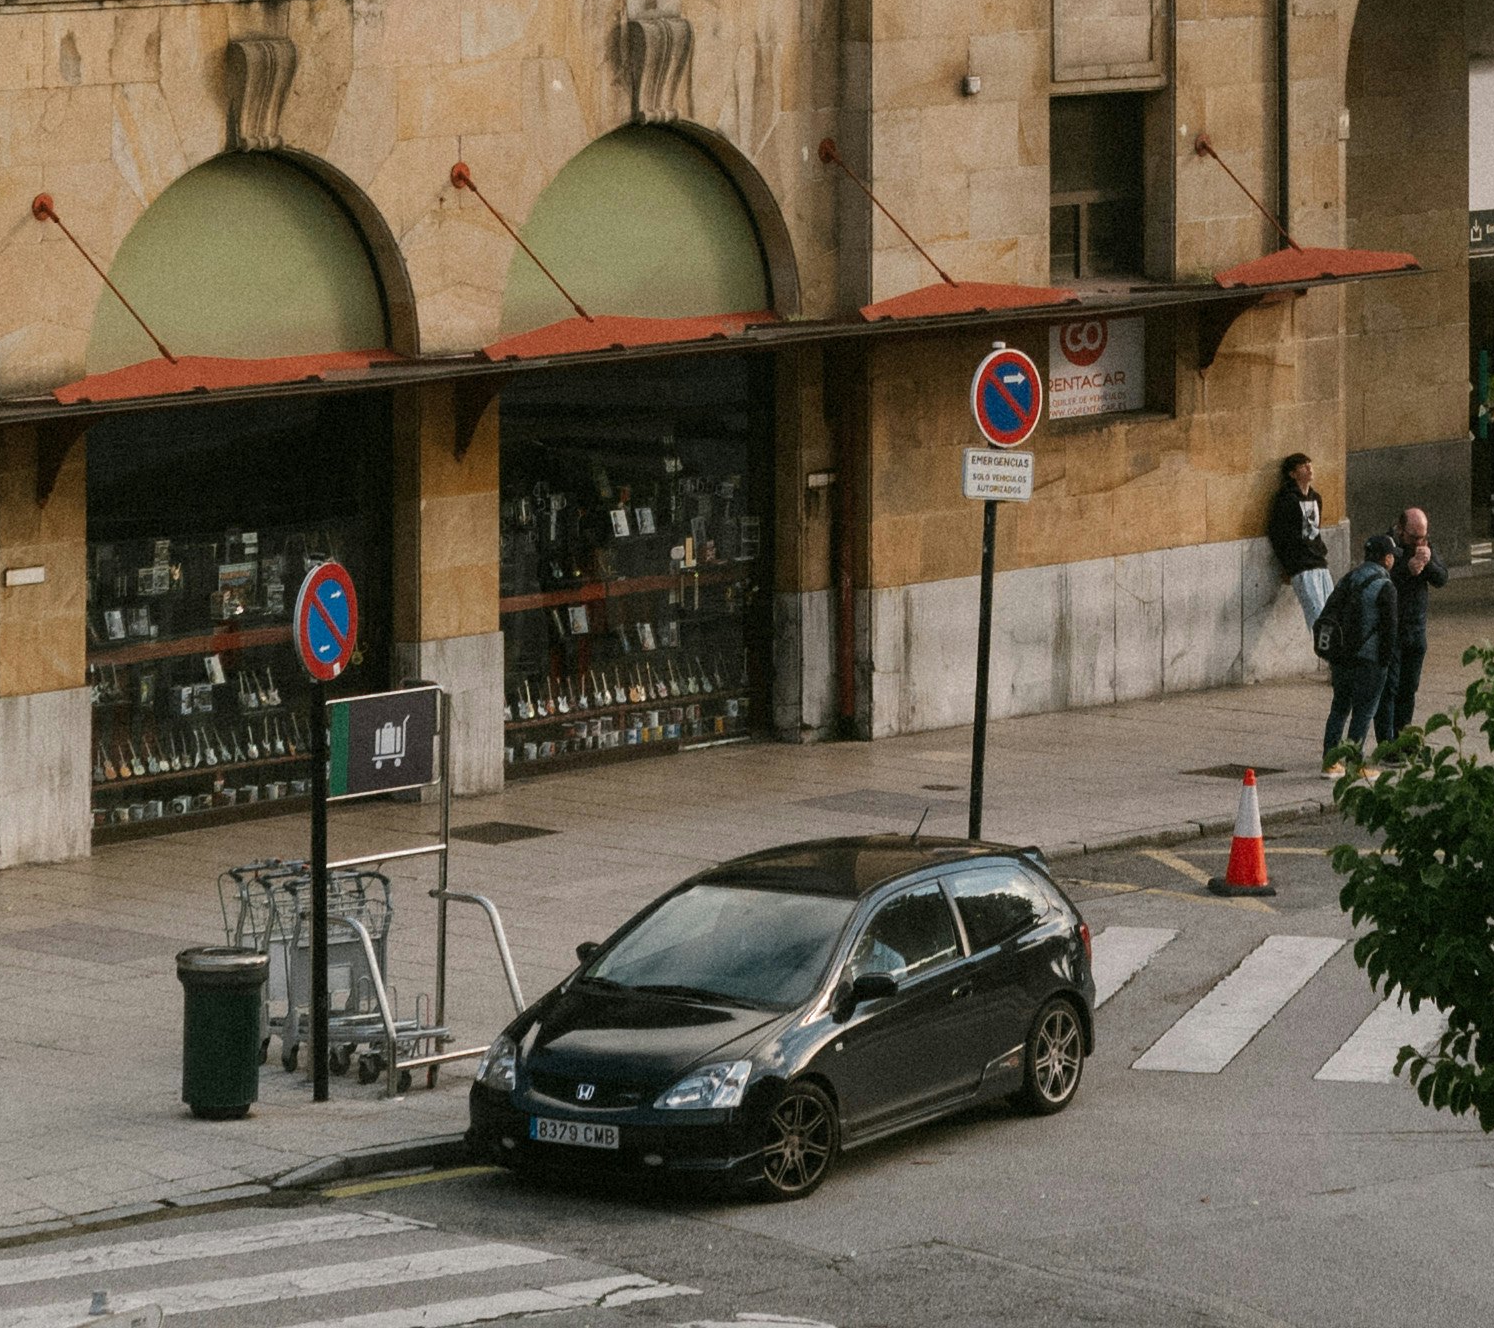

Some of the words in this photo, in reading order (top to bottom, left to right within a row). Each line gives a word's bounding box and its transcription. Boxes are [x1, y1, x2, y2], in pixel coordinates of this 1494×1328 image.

[1066, 321, 1104, 353] GO
[971, 455, 1029, 468] EMERGENCIAS
[539, 1120, 579, 1141] 8379
[583, 1126, 615, 1145] CMB
